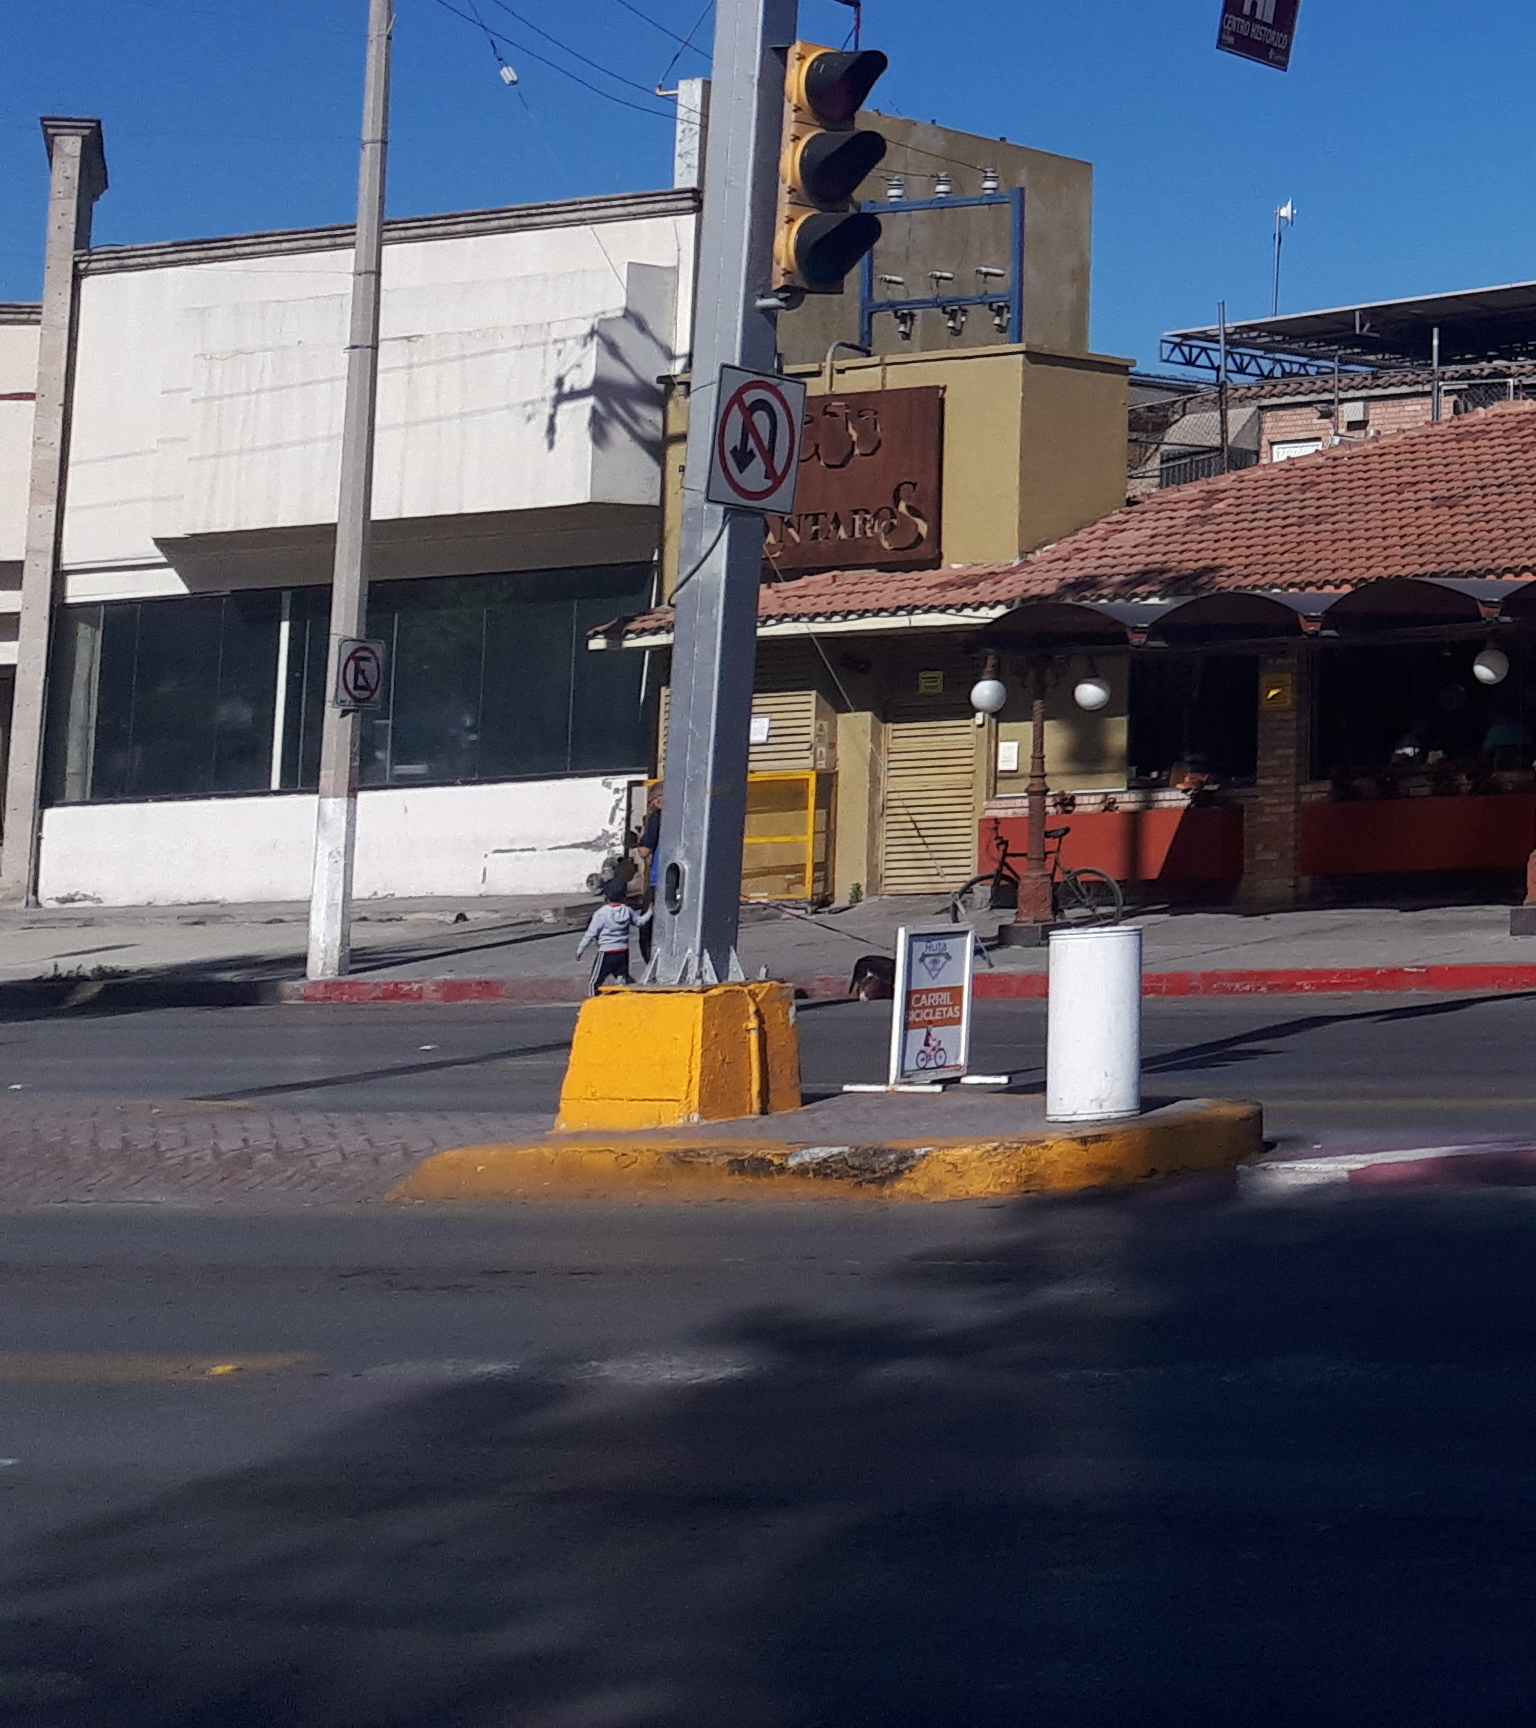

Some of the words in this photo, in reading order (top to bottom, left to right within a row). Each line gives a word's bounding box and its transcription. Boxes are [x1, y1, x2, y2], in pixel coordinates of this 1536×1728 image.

[1223, 12, 1251, 37] CENTRO
[925, 942, 947, 953] Ruta
[911, 991, 953, 1008] CARRIL
